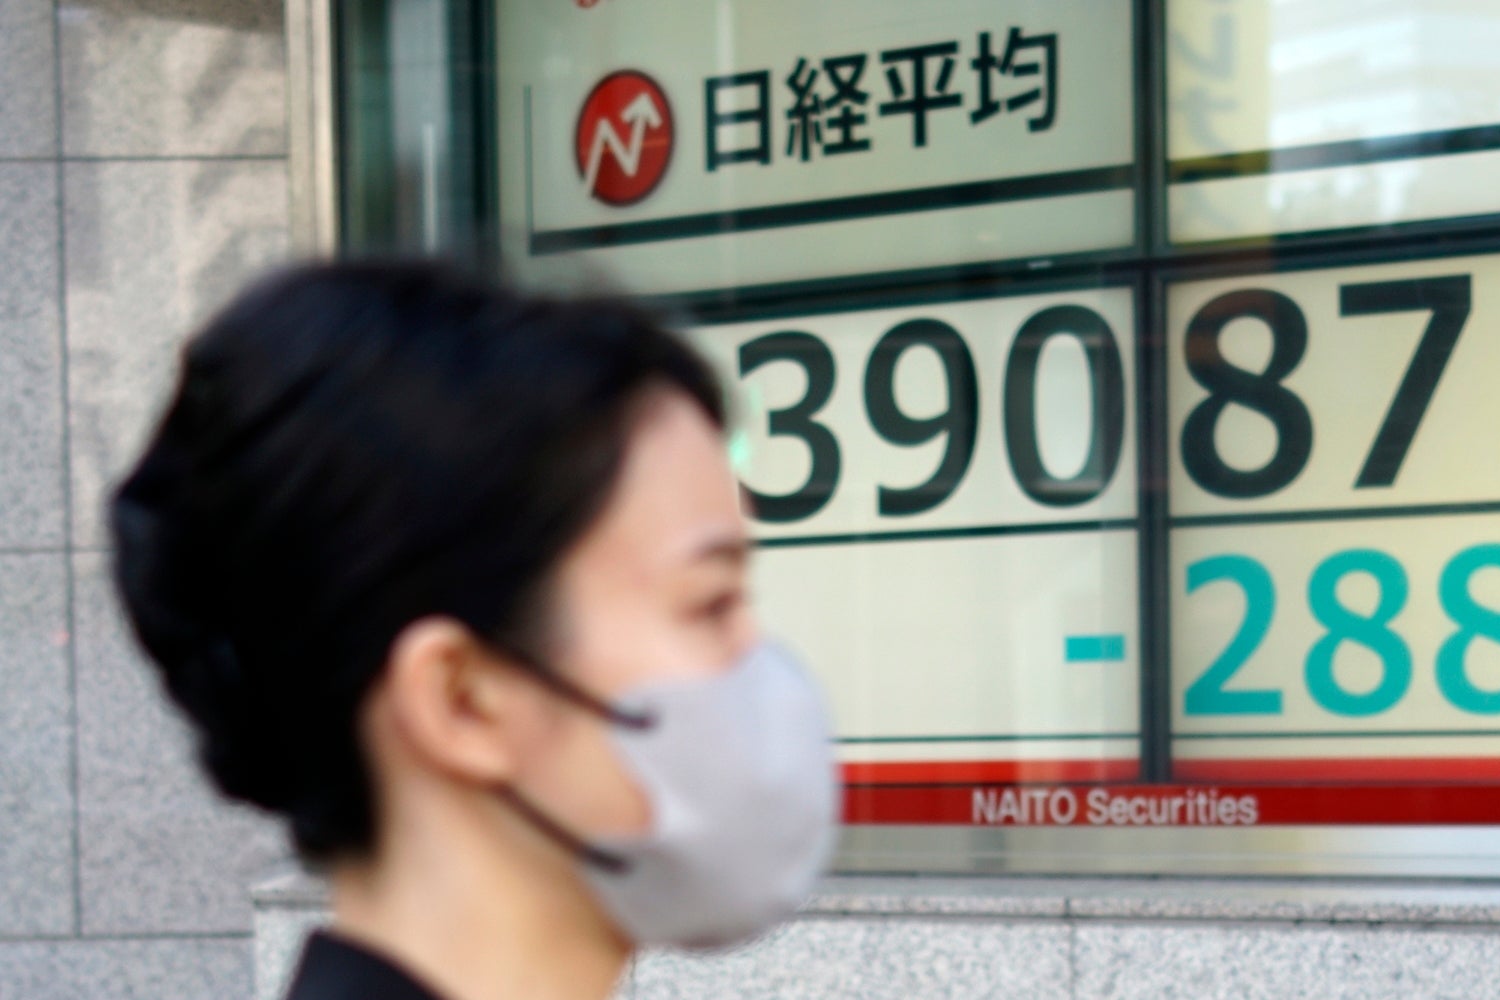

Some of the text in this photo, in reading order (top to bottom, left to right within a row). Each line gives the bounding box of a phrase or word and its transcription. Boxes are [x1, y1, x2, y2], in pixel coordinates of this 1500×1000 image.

[704, 26, 1059, 171] 日経平均
[972, 788, 1259, 826] NAITO Securities
